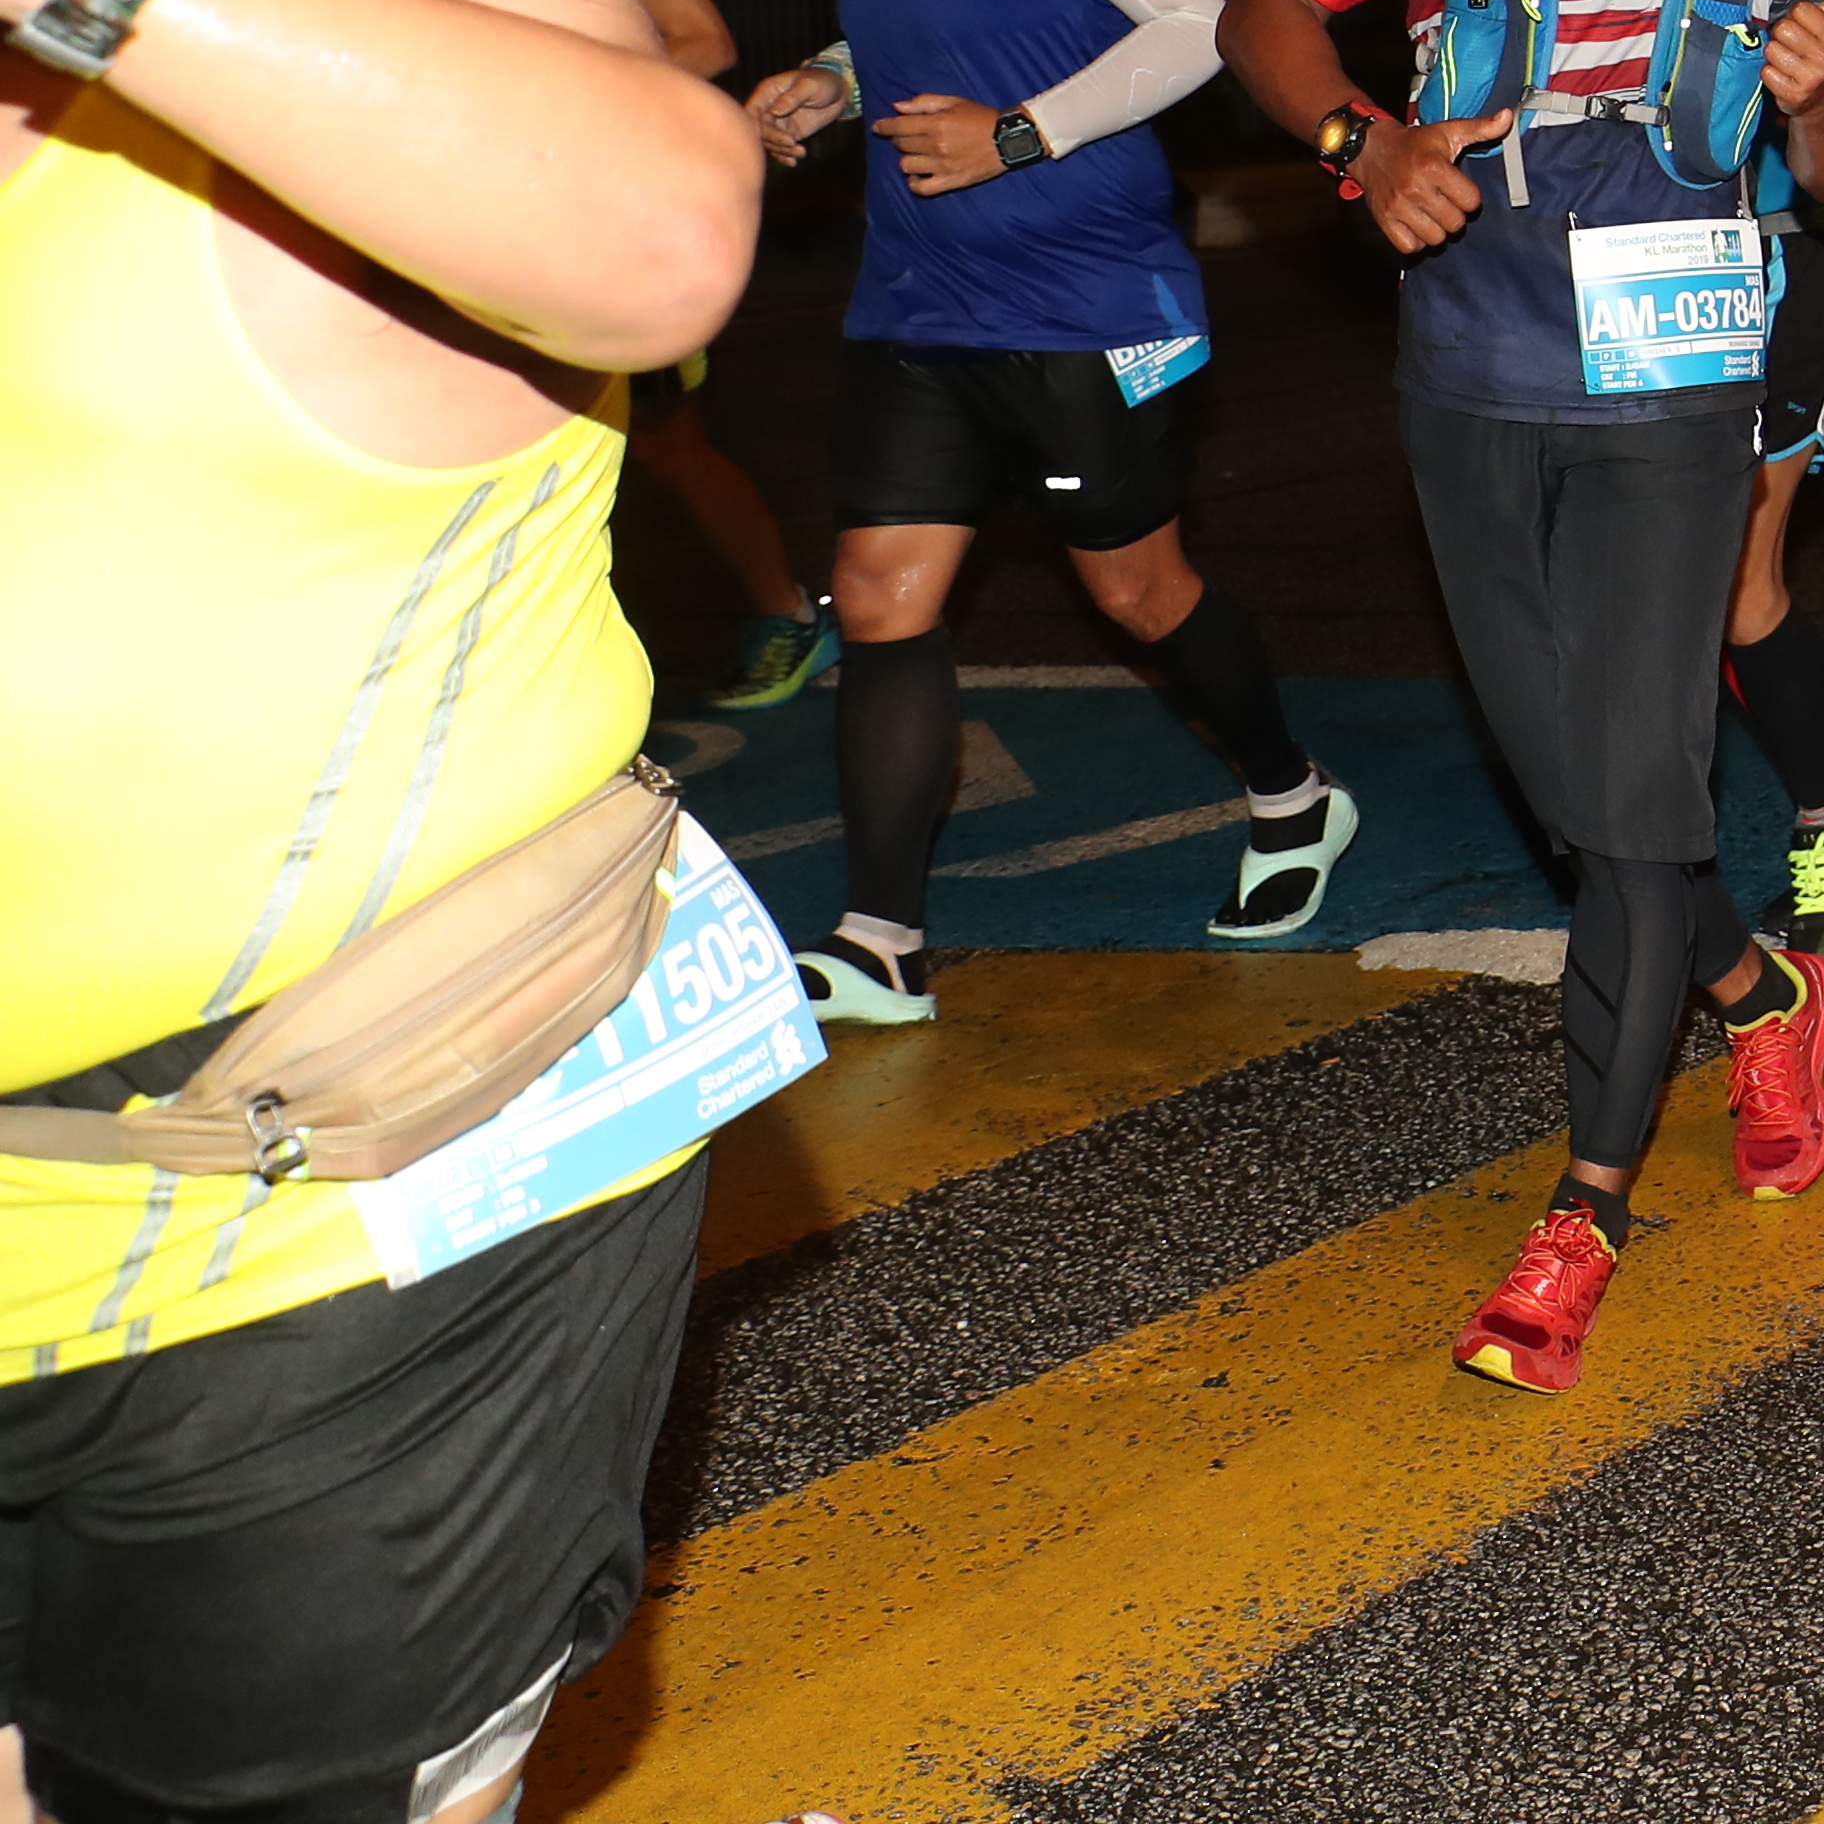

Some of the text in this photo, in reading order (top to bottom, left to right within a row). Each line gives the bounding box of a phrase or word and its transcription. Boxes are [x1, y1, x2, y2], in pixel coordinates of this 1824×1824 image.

[1605, 230, 1706, 248] Standard Chartered
[1644, 243, 1708, 256] KL Marathon
[1688, 255, 1709, 266] 2019
[1745, 274, 1760, 286] MAS
[1588, 288, 1762, 342] AM-03784
[710, 878, 742, 911] MAS
[697, 1040, 770, 1096] Standard
[697, 1060, 776, 1119] Chartered
